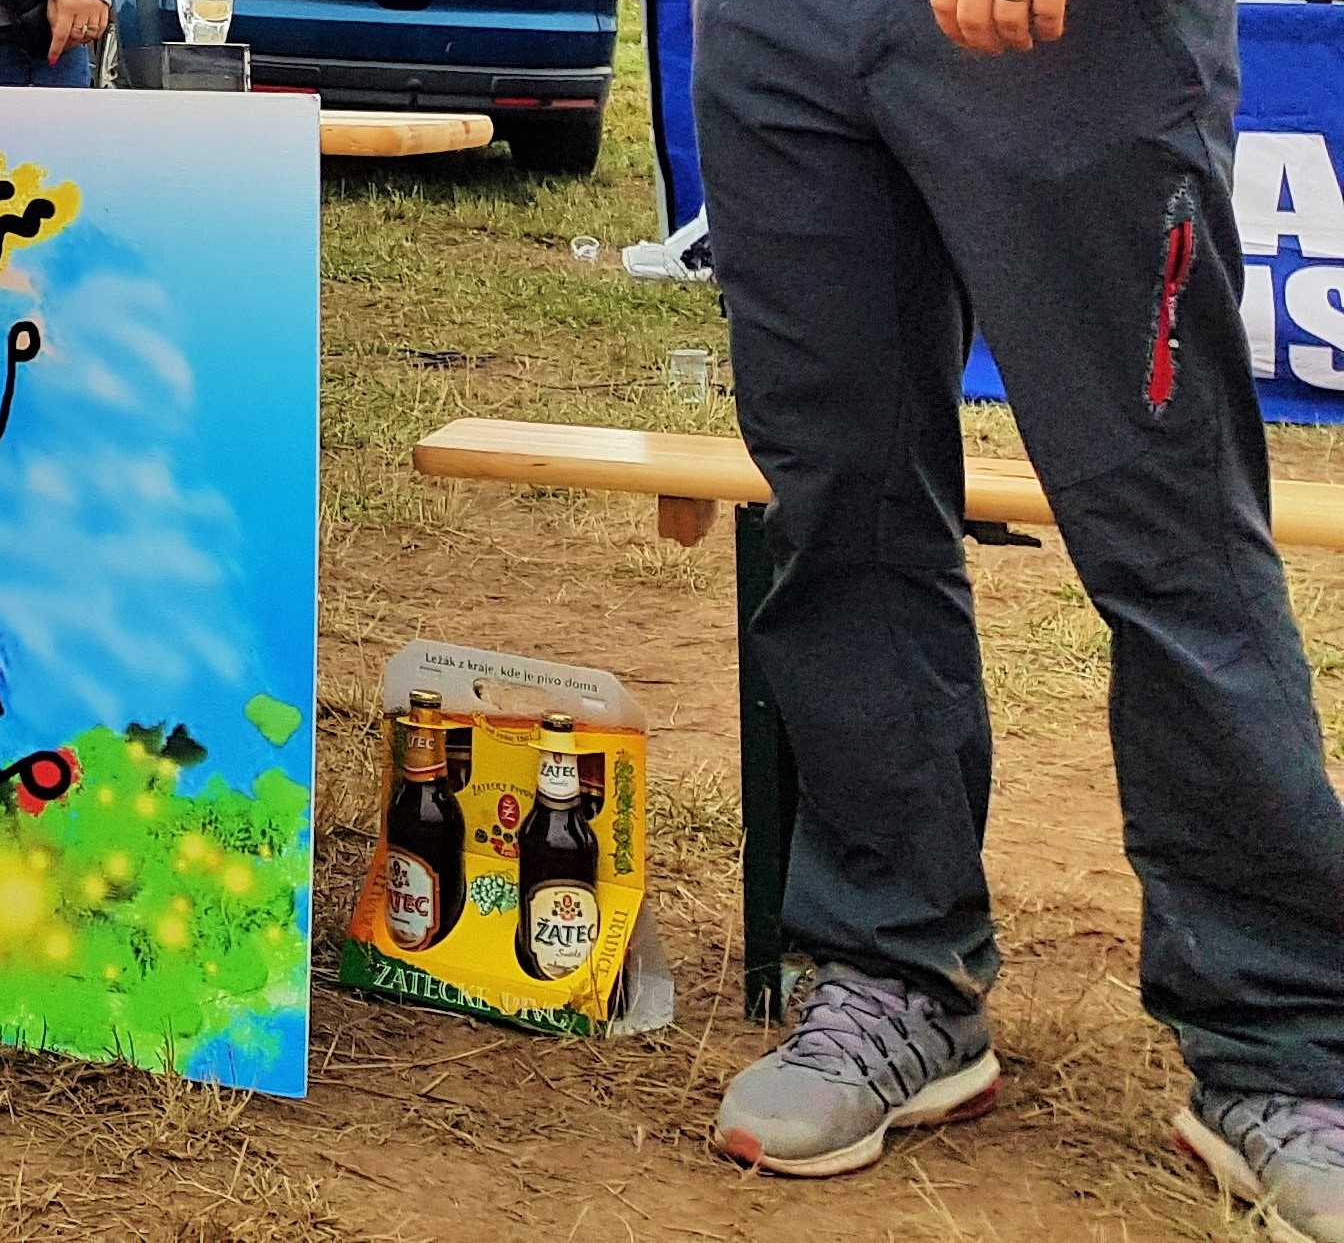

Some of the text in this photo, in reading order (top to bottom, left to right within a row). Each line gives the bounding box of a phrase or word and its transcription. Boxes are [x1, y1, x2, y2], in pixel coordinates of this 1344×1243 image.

[424, 652, 456, 667] Ležák
[500, 667, 521, 678] kde
[523, 669, 534, 682] je
[537, 672, 561, 686] pivo
[564, 677, 598, 693] doma
[407, 735, 435, 751] TEC
[534, 917, 597, 948] ŽATEC
